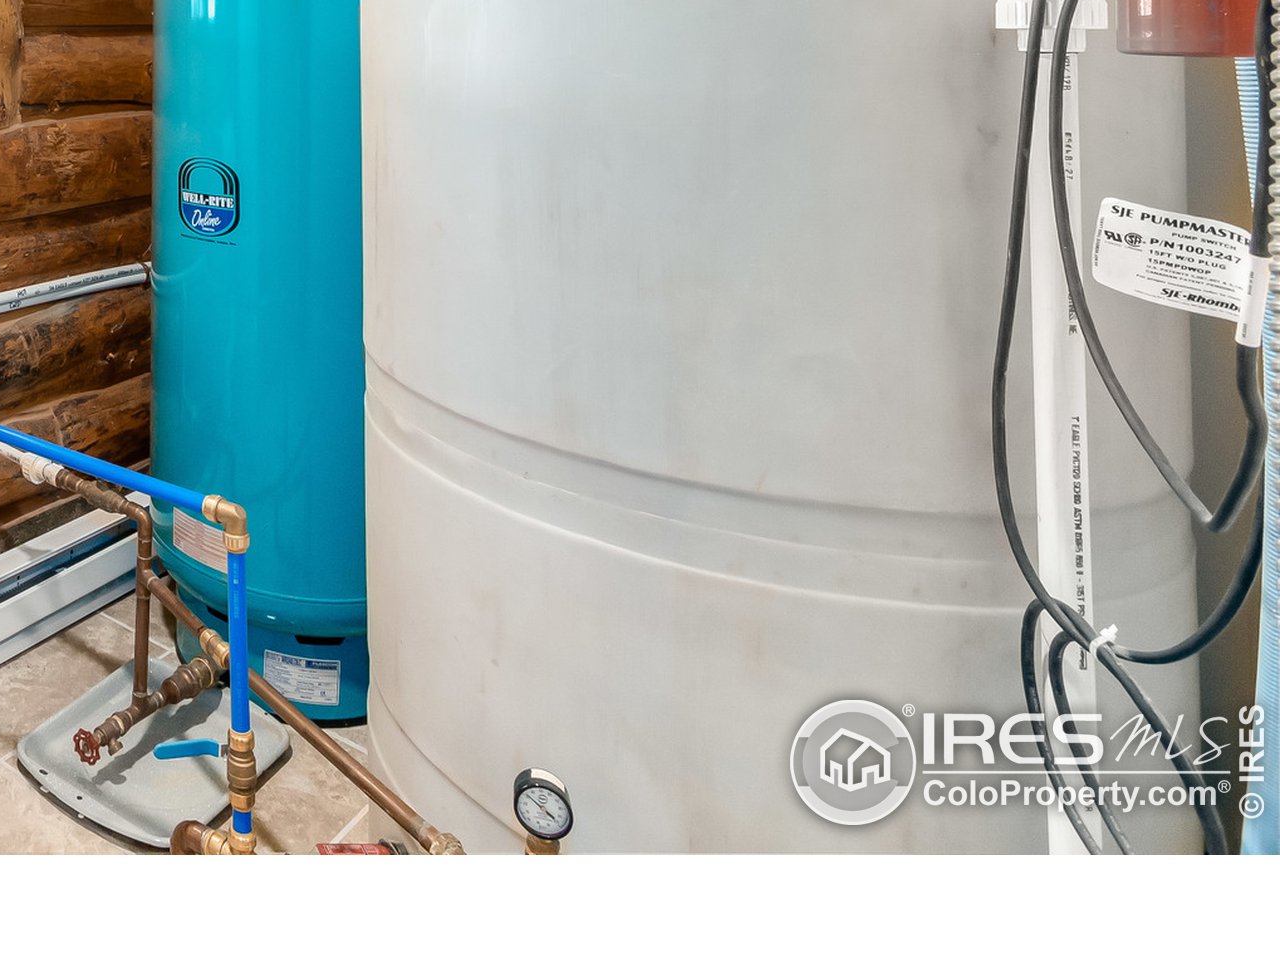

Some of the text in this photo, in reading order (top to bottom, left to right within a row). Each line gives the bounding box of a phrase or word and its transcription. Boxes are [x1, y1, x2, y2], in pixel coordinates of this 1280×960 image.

[182, 191, 235, 209] WELL-RITE
[1111, 204, 1135, 218] SJE
[1149, 237, 1241, 265] P/N1003247
[1171, 232, 1237, 251] PUMP SWITCH
[1149, 249, 1227, 270] 15FT W/O PLUG
[1160, 287, 1241, 313] SJE-Rhomb
[1073, 507, 1084, 530] ASTM
